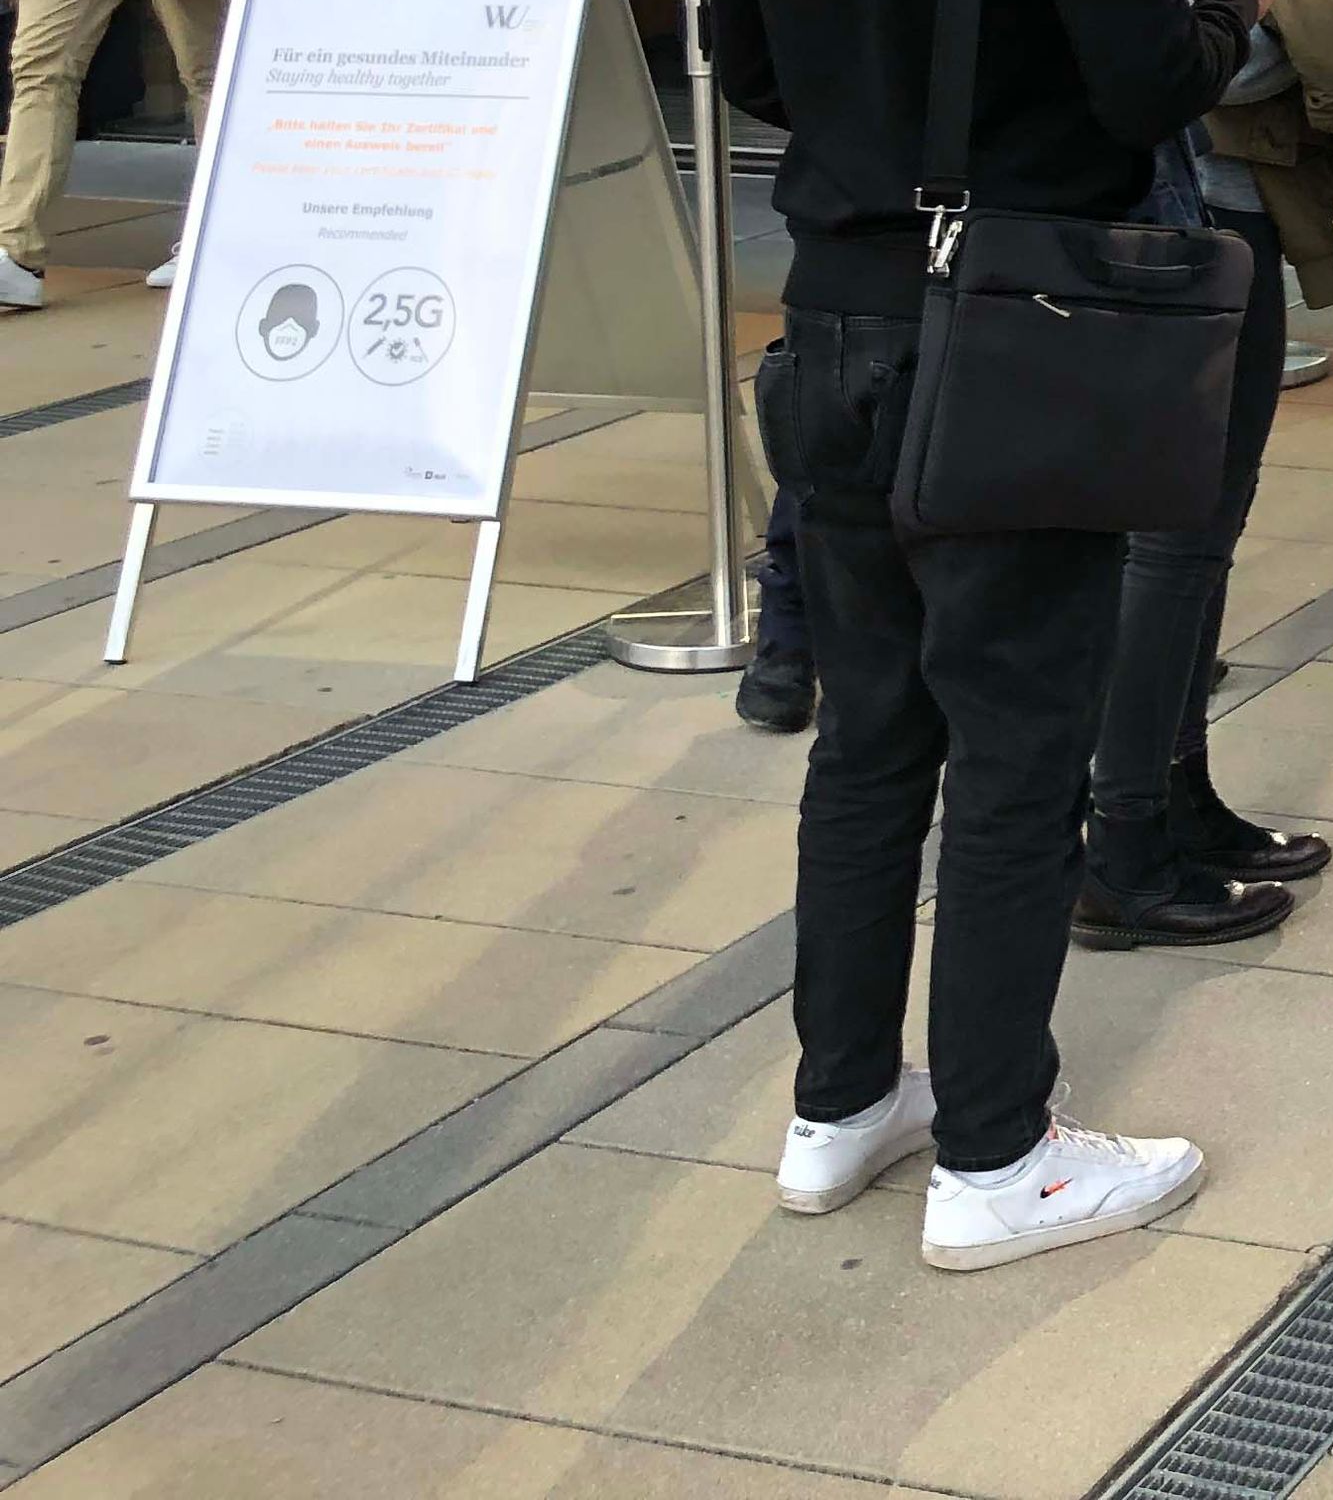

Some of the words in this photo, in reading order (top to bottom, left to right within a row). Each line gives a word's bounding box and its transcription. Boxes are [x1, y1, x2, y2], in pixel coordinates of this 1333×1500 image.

[482, 4, 531, 30] WU
[272, 46, 304, 64] Für
[306, 48, 333, 64] ein
[336, 49, 417, 67] gesundes
[420, 50, 530, 68] Miteinander
[265, 67, 325, 87] Staying
[327, 69, 385, 89] healthy
[387, 71, 452, 89] together
[302, 201, 349, 215] Unsere
[351, 203, 434, 221] Empfehlung
[317, 227, 409, 242] Recommended
[362, 293, 445, 332] 2,5G
